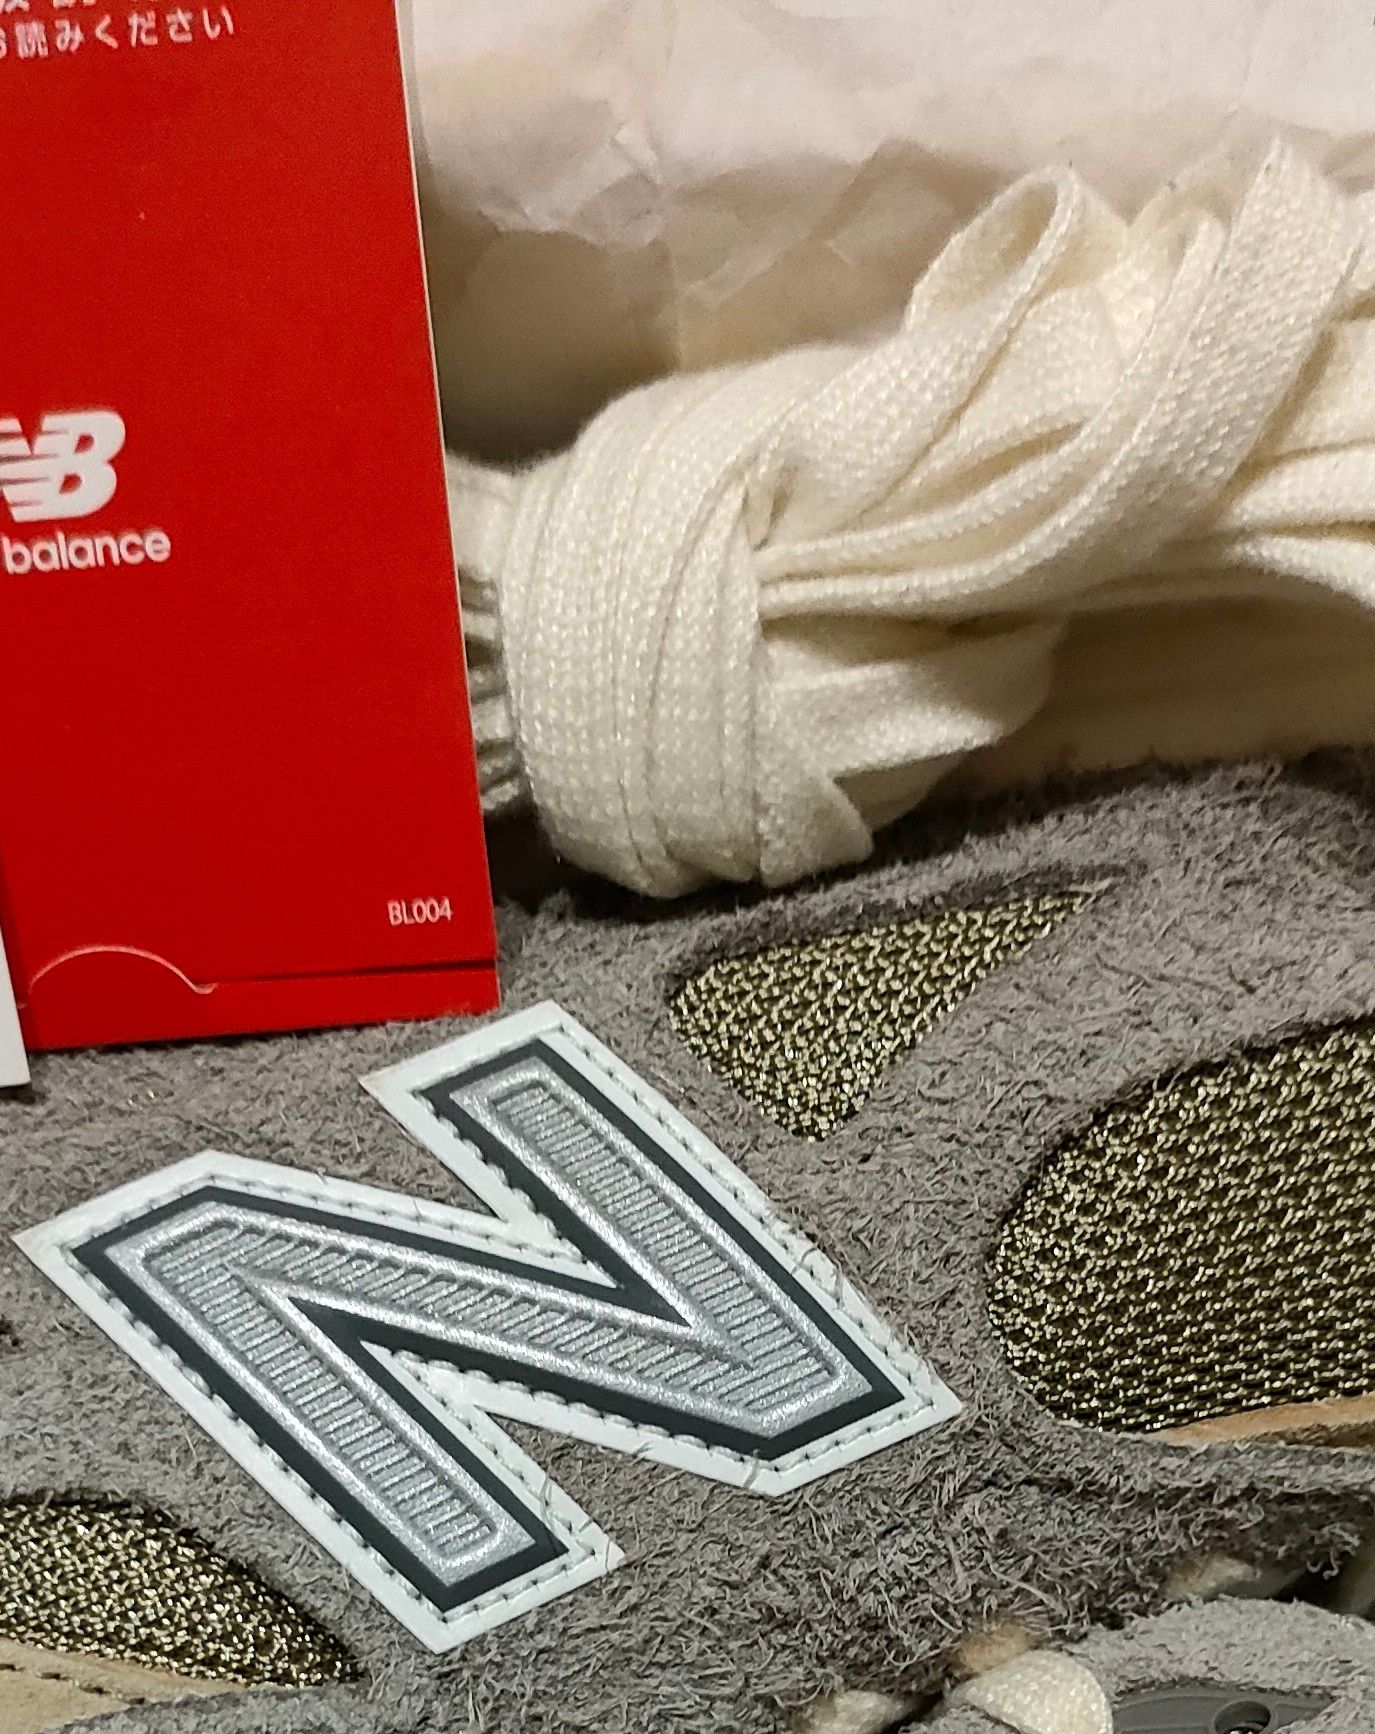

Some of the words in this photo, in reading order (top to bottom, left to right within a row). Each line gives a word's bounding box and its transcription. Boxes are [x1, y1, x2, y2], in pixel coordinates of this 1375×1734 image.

[1, 522, 172, 575] balance
[387, 897, 453, 926] BL004
[14, 1001, 961, 1653] N
